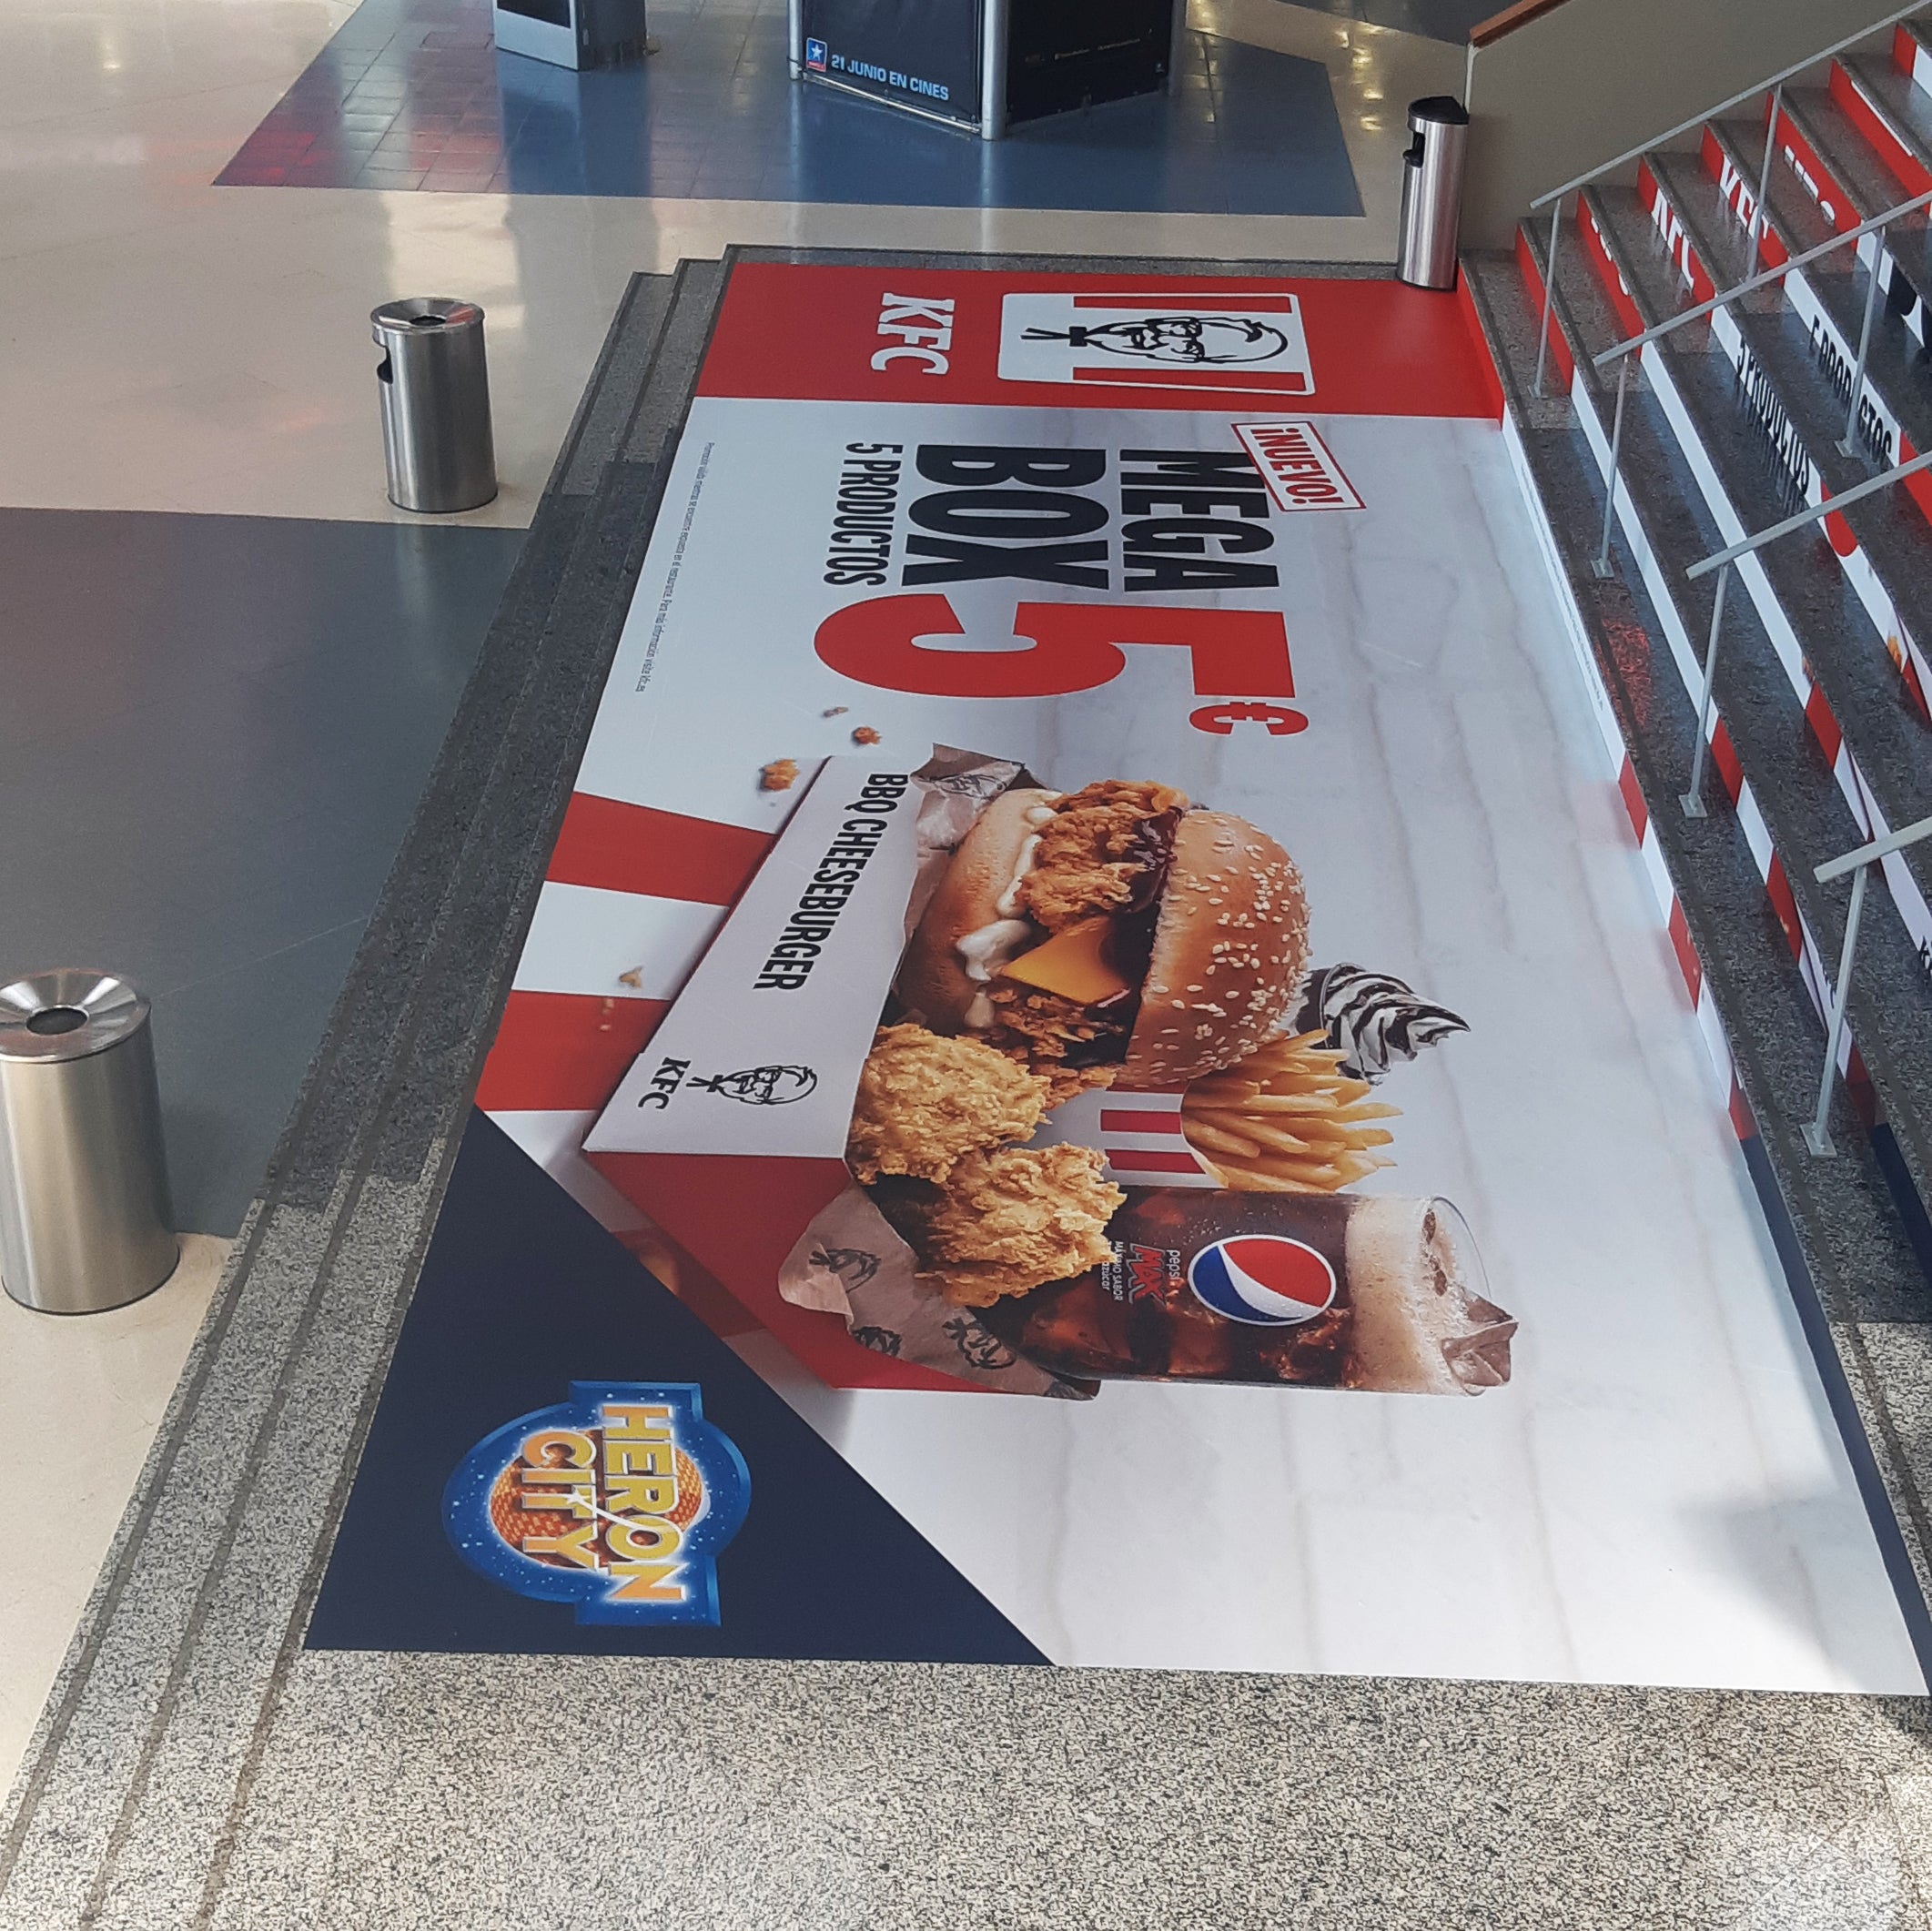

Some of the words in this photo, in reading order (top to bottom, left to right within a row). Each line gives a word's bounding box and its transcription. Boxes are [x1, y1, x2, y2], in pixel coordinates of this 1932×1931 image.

[832, 55, 845, 70] 21
[847, 60, 886, 82] JUNIO
[889, 71, 907, 88] EN
[910, 77, 949, 101] CINES
[871, 292, 956, 376] KFC
[845, 443, 904, 455] 5
[1249, 427, 1345, 506] ¡NUEVO!
[823, 458, 902, 586] PRODUCTOS
[901, 443, 1110, 591] BOX
[1119, 449, 1280, 592] MEGA
[844, 773, 909, 814] BBQ
[753, 818, 888, 990] CHEESEBURGER
[638, 1056, 692, 1110] KFC
[1112, 1274, 1123, 1301] SABOR
[1126, 1242, 1167, 1308] MAX
[1166, 1249, 1181, 1280] pepsi
[521, 1430, 599, 1572] CITY
[600, 1404, 687, 1602] HERON
